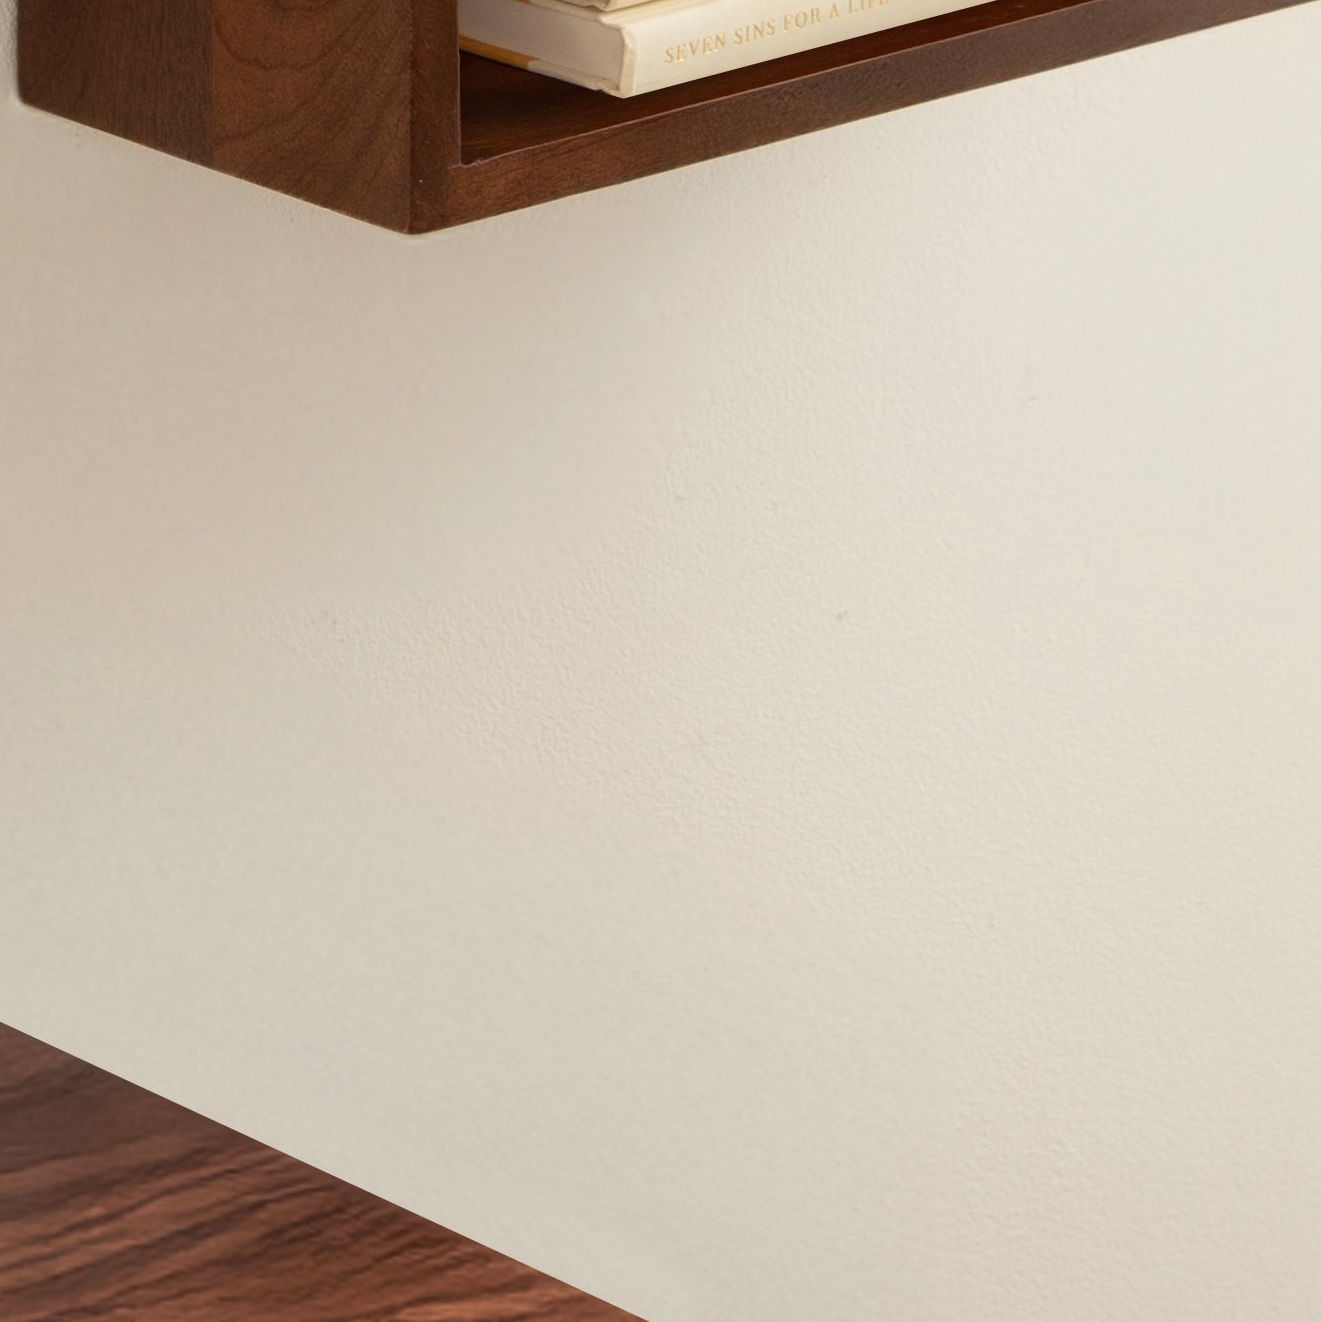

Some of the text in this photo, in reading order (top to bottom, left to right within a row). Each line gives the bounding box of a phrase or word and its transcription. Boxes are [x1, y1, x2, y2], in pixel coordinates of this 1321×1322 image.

[663, 31, 727, 64] SEVEN
[733, 19, 776, 46] SINS
[783, 7, 821, 33] FOR
[829, 2, 840, 19] A
